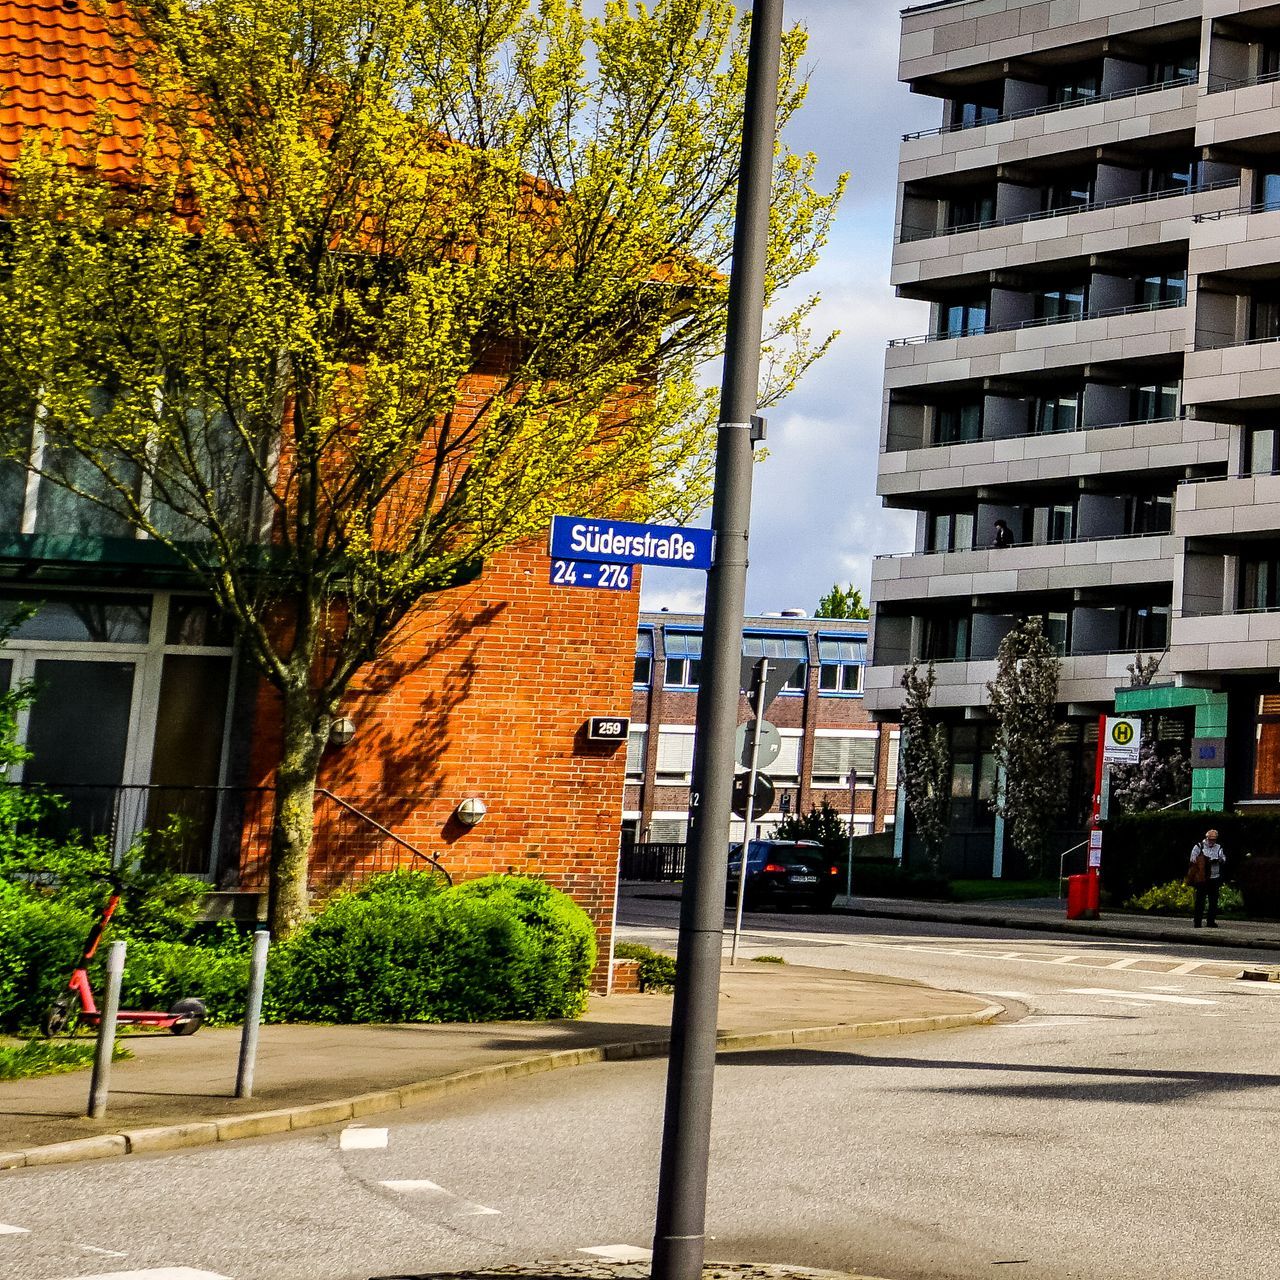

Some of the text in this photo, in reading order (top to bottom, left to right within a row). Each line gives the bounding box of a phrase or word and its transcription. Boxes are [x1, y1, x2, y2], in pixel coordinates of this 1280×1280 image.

[570, 524, 695, 561] Süderstraße
[553, 560, 576, 584] 24
[597, 564, 629, 588] 276
[598, 722, 622, 735] 259
